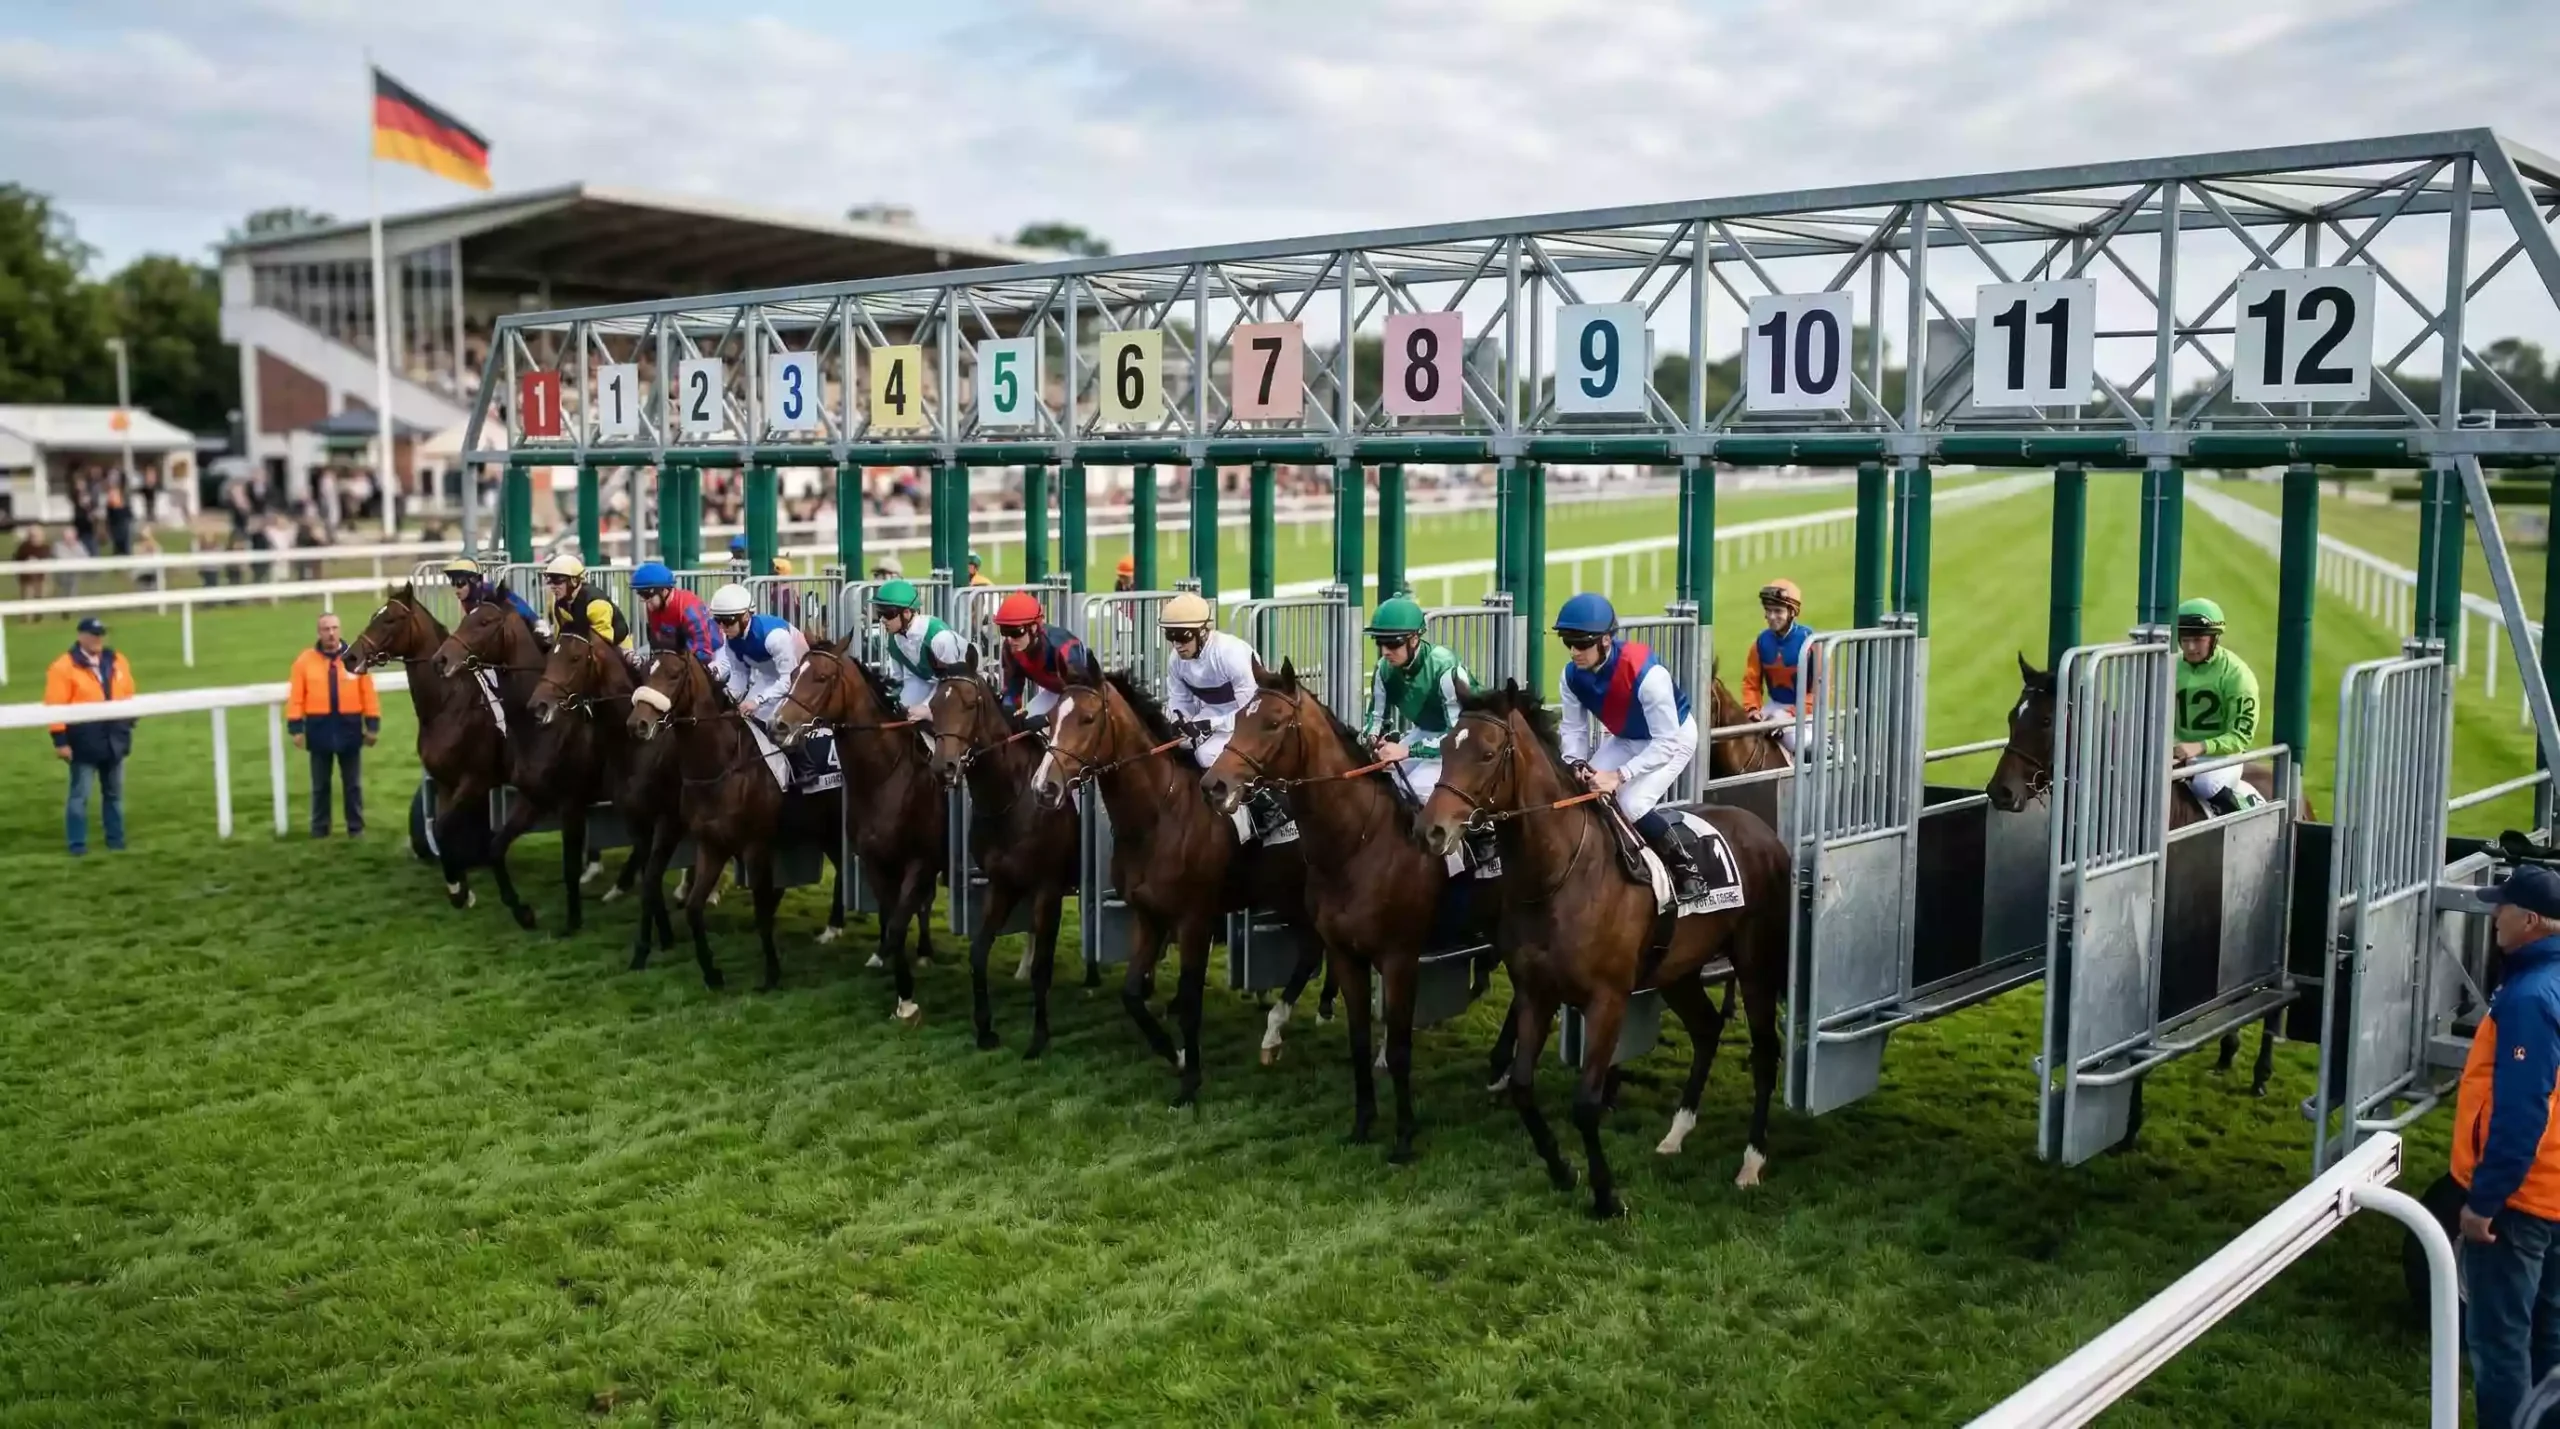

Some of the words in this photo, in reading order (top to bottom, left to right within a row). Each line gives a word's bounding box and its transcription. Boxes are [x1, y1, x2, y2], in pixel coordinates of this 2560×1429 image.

[1404, 327, 1440, 402] 8
[1579, 319, 1620, 399] 9
[1758, 308, 1840, 395] 10
[1993, 297, 2070, 390] 11
[2247, 286, 2356, 386] 12
[609, 375, 622, 425] 1
[690, 370, 710, 422] 2
[782, 364, 803, 420] 3
[884, 358, 907, 416] 4
[993, 351, 1018, 413] 5
[1116, 343, 1145, 410] 6
[1252, 337, 1283, 406] 7
[533, 380, 546, 427] 1
[2176, 688, 2222, 731] 12
[2236, 696, 2256, 717] 12
[827, 738, 842, 770] 4
[1713, 837, 1735, 884] 1
